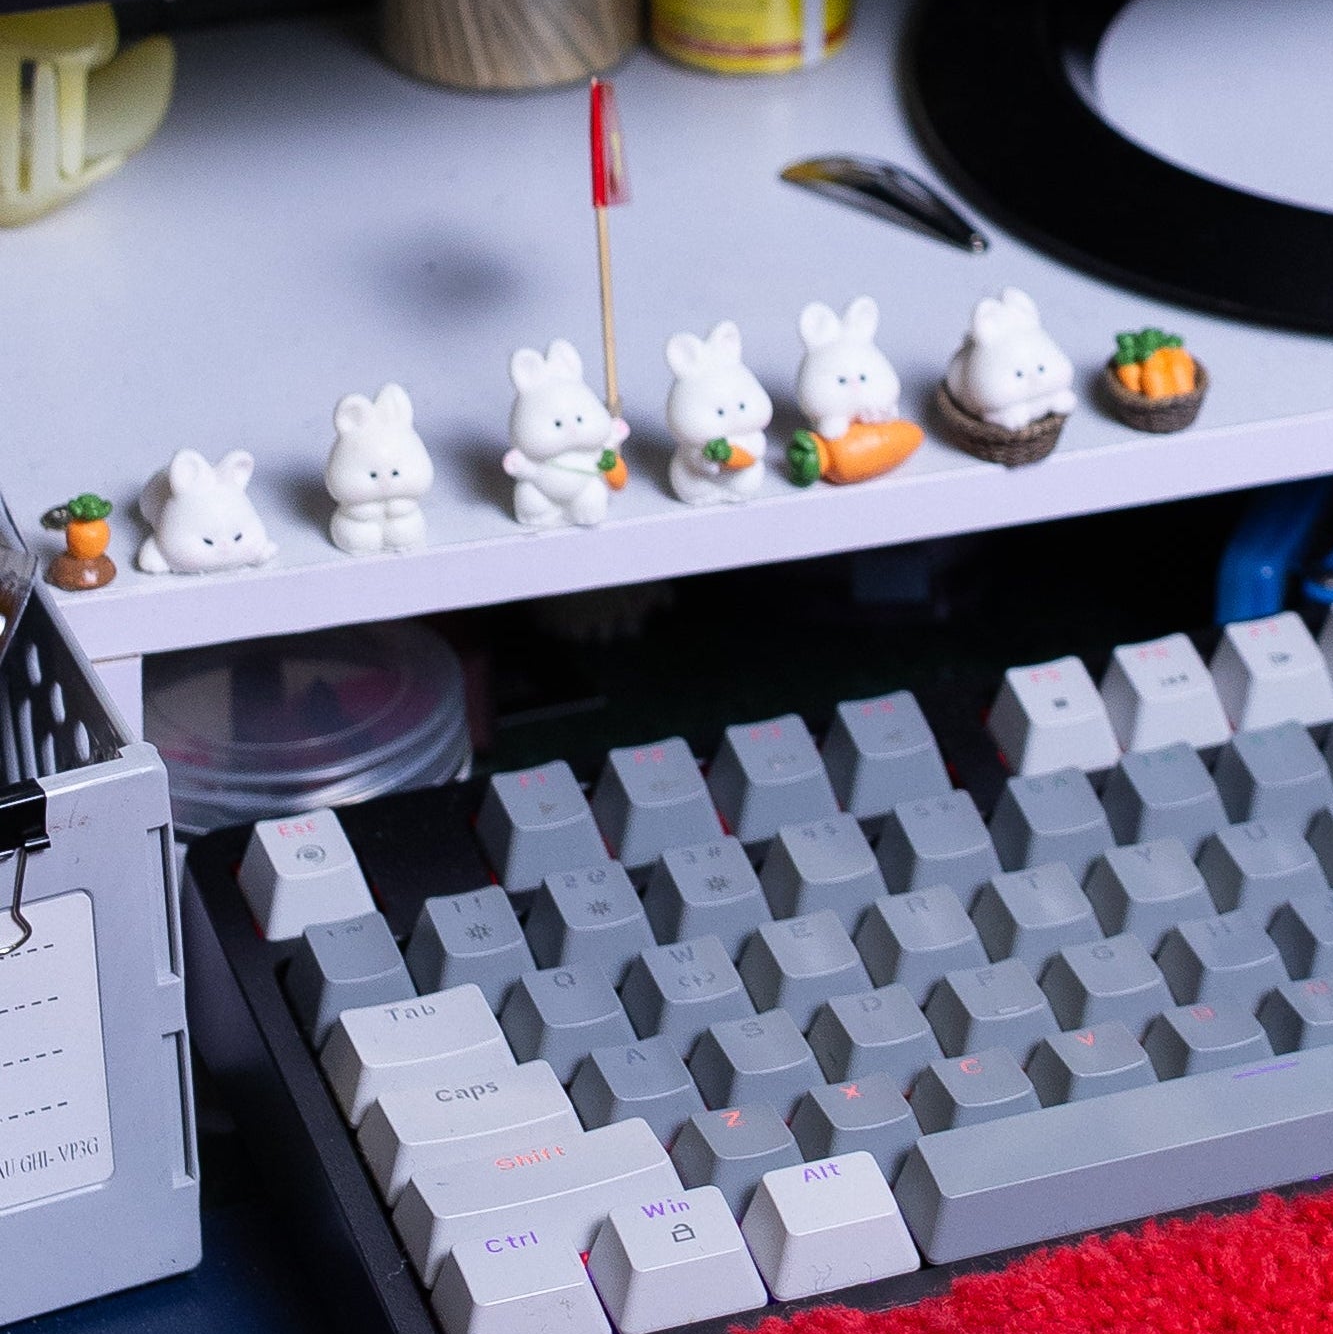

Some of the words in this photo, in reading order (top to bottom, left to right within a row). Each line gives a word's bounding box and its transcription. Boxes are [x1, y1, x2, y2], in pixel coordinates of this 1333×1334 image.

[669, 943, 695, 964] W
[553, 970, 577, 990] Q
[384, 1003, 436, 1021] Tab
[1075, 1031, 1096, 1047] V
[626, 1046, 648, 1064] A
[959, 1058, 984, 1075] C
[435, 1080, 499, 1103] Caps
[839, 1082, 865, 1100] X
[720, 1109, 746, 1128] Z
[495, 1145, 566, 1171] Shift
[803, 1161, 840, 1183] Alt
[641, 1198, 691, 1218] Win
[484, 1230, 538, 1254] Ctrl
